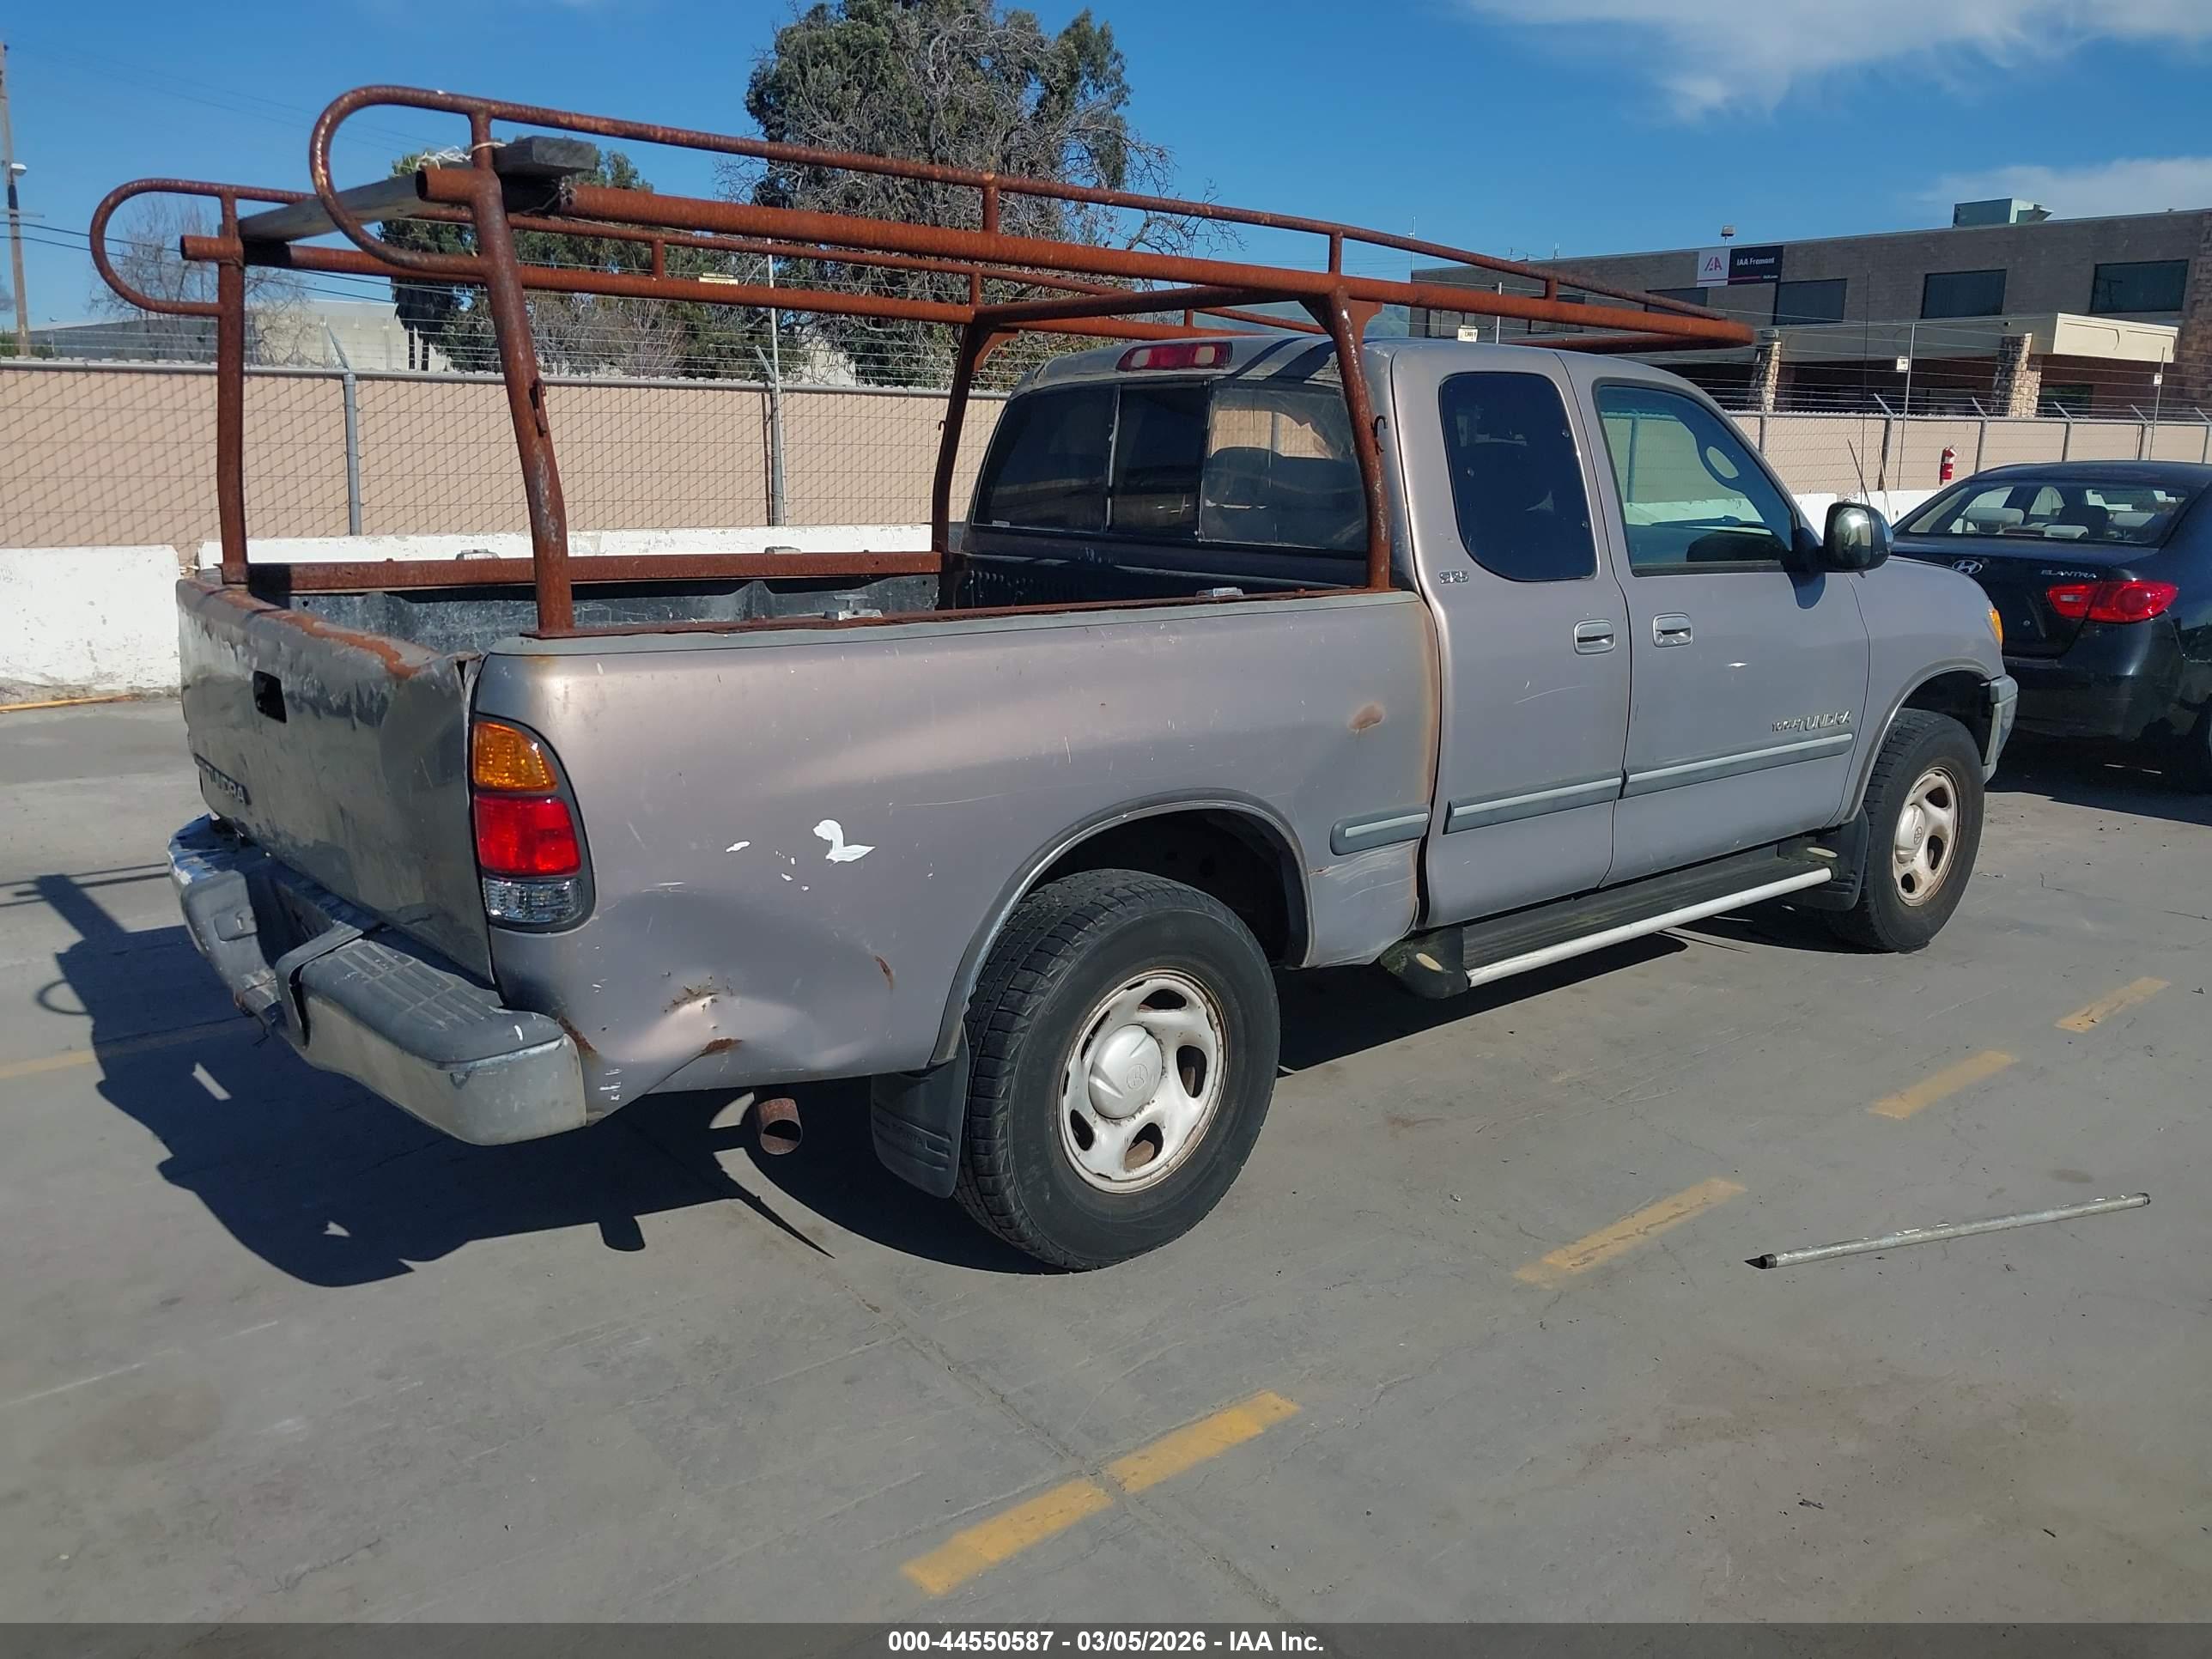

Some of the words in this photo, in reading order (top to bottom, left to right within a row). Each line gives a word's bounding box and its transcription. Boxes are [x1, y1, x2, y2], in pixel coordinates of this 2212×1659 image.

[1736, 258, 1748, 266] IAA
[1749, 257, 1775, 265] Fremont
[1439, 570, 1469, 584] SR5
[2040, 569, 2097, 578] ELANTRA
[1797, 710, 1851, 732] TUNDRA
